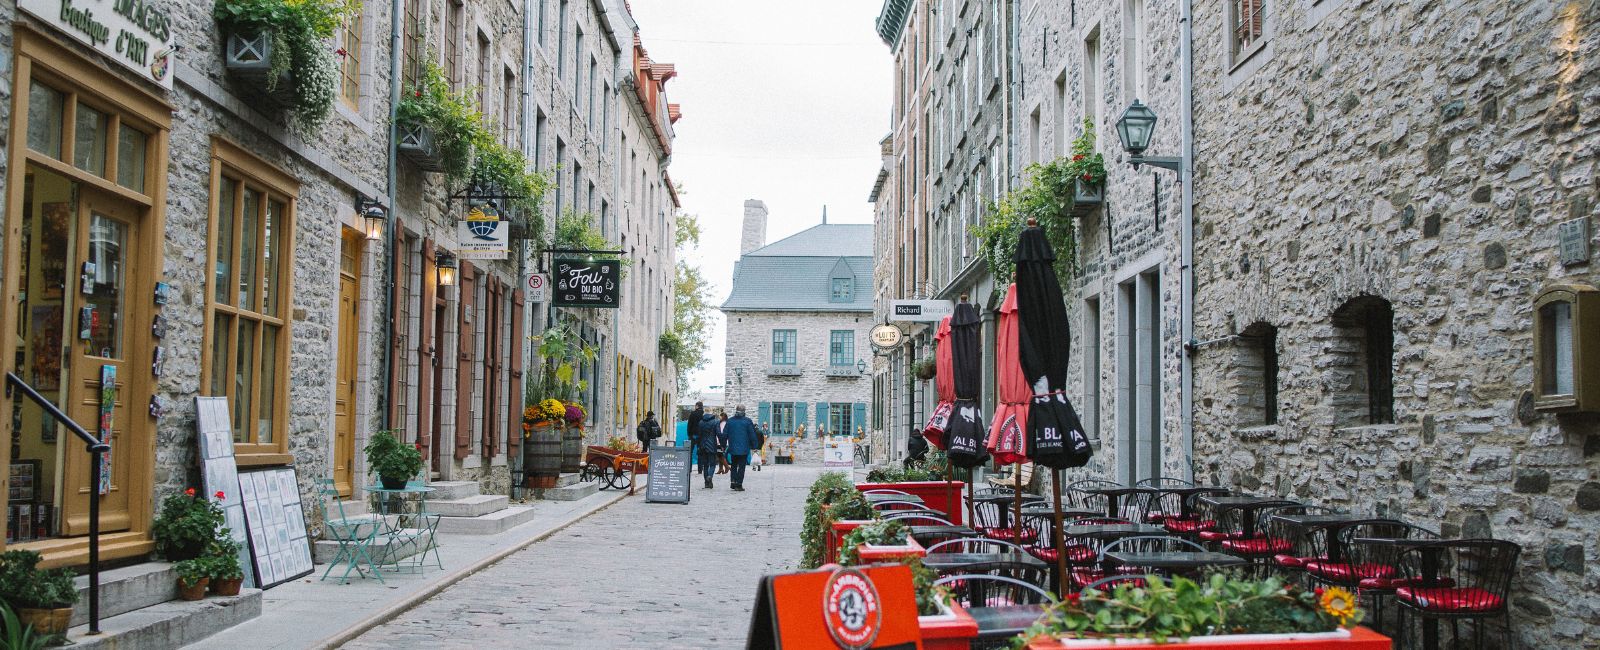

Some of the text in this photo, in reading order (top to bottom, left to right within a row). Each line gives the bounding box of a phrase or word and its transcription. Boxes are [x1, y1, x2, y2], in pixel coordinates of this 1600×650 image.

[569, 266, 603, 289] Fou
[581, 285, 603, 293] DU BIO
